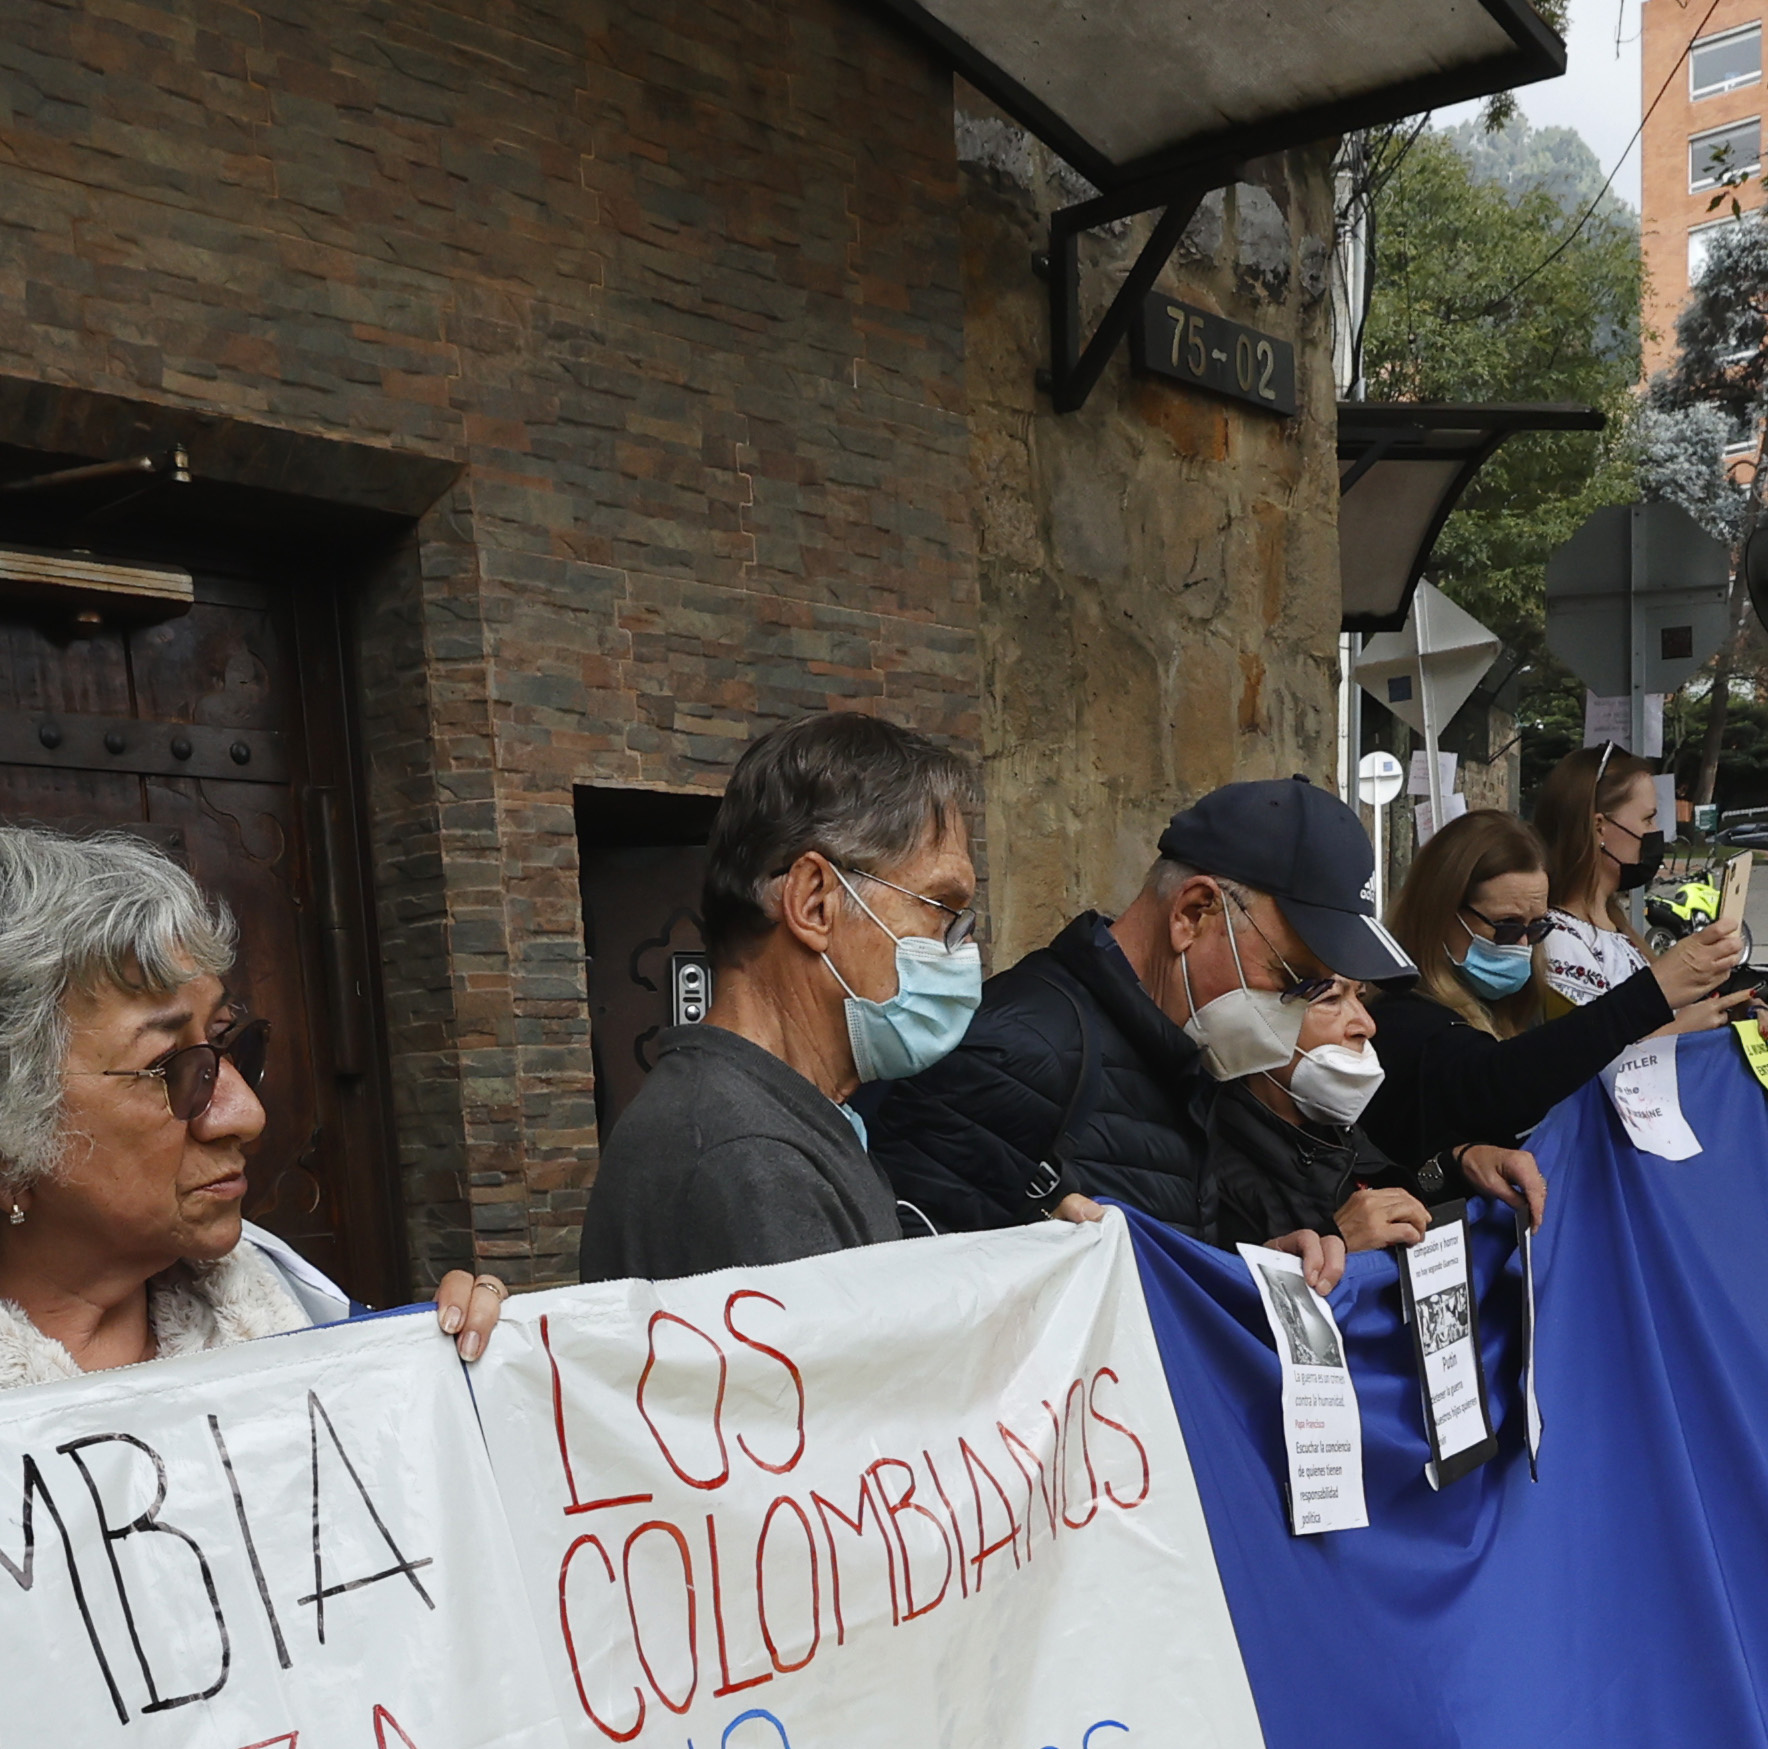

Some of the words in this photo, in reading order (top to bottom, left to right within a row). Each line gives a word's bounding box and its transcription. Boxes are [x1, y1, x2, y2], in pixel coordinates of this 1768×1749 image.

[1166, 305, 1276, 400] 75-02
[539, 1288, 806, 1516] LOS
[1296, 1441, 1319, 1454] Escuchar
[1298, 1464, 1305, 1478] de
[558, 1366, 1151, 1743] COLOMBIANOS
